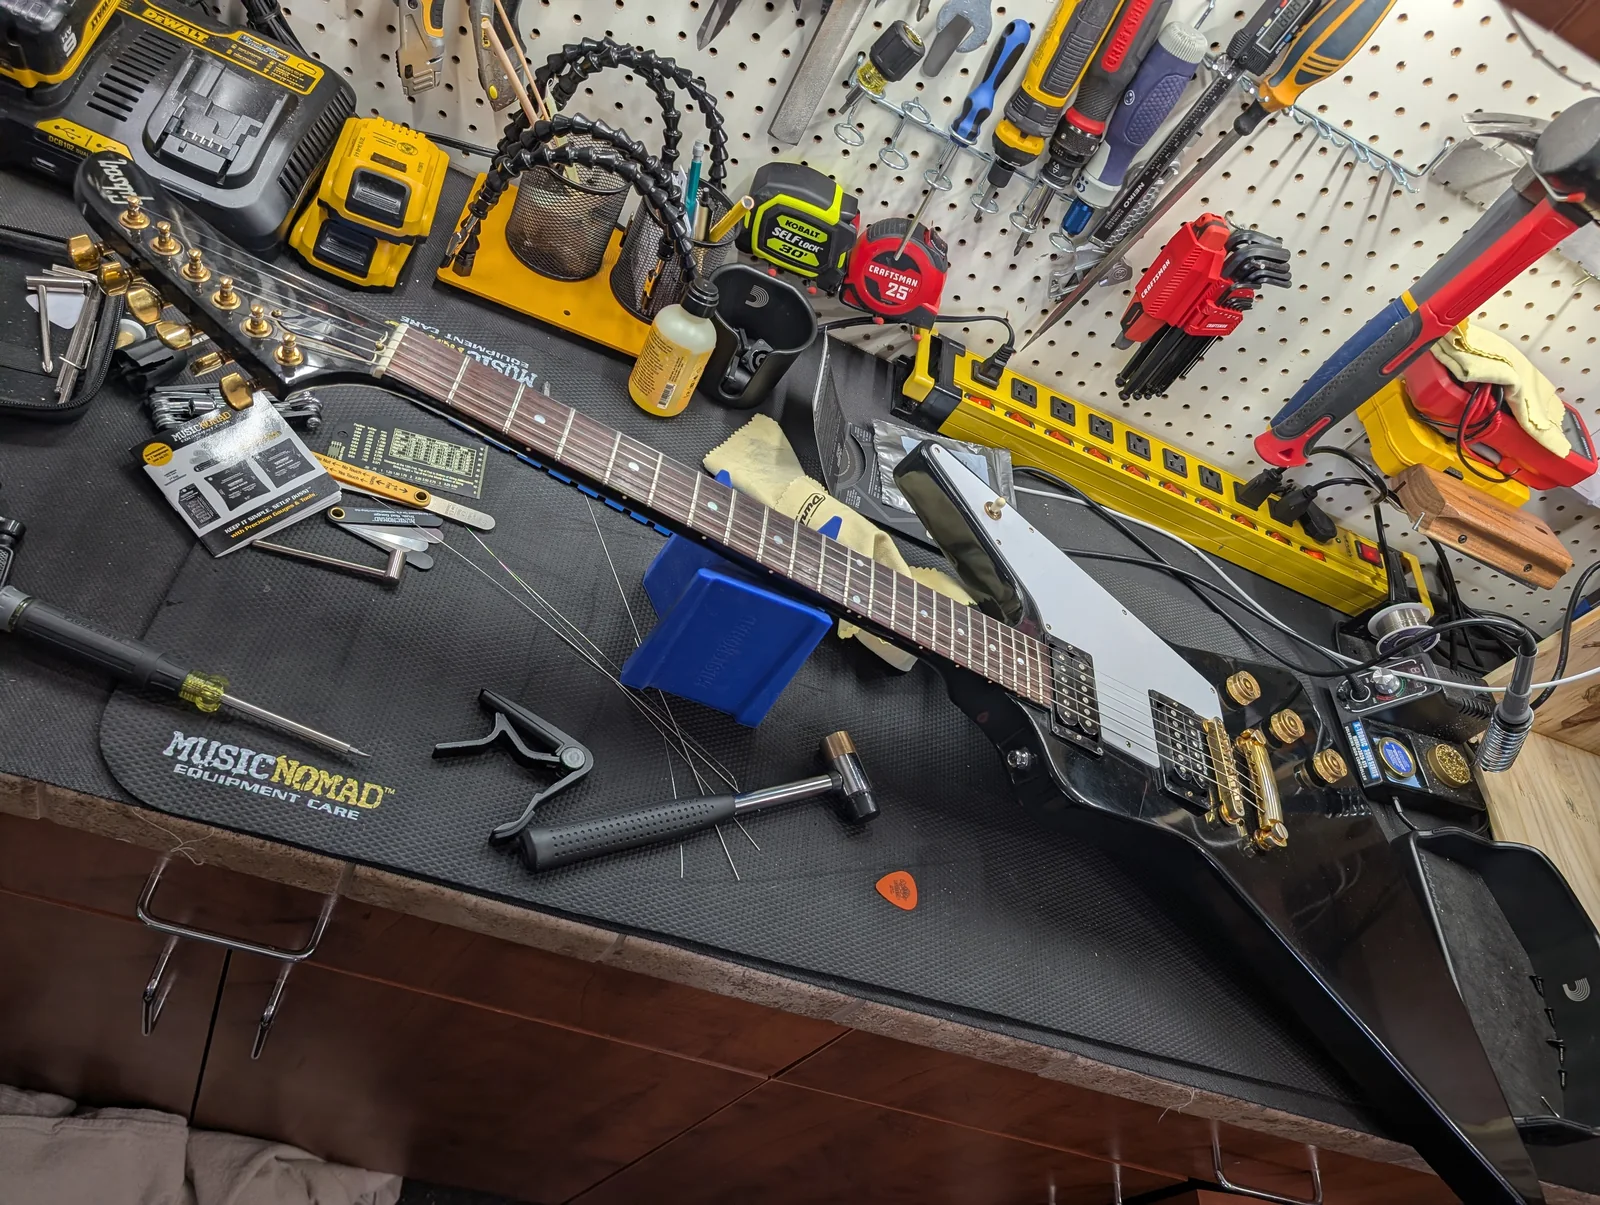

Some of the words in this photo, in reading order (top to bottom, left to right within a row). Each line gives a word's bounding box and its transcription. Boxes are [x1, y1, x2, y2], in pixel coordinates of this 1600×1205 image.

[61, 25, 73, 43] AH
[142, 8, 209, 43] DEWALT
[1105, 0, 1148, 67] CRAFTSMA
[63, 32, 77, 57] 6
[47, 135, 75, 151] DCB102
[98, 159, 155, 205] Gibson
[1123, 182, 1145, 208] NEIKO
[785, 219, 821, 239] KOBALT
[779, 244, 808, 259] 30'
[869, 264, 919, 287] CRAFTSMAN
[1140, 259, 1171, 298] CRAFTSMAN
[400, 315, 440, 335] CARE
[444, 333, 529, 369] EQUIPMENT
[224, 522, 241, 534] KEEP
[240, 518, 248, 526] IT
[271, 496, 291, 509] SETUP
[230, 527, 245, 539] with
[244, 513, 273, 531] Precision
[272, 502, 294, 518] Gauges
[691, 610, 761, 692] MUSICNOMAD
[1352, 722, 1368, 747] X-TRONIC
[1366, 760, 1379, 778] SERIES
[162, 730, 397, 810] MUSICNOMAD™
[174, 763, 301, 803] EQUIPMENT
[306, 798, 360, 821] CARE
